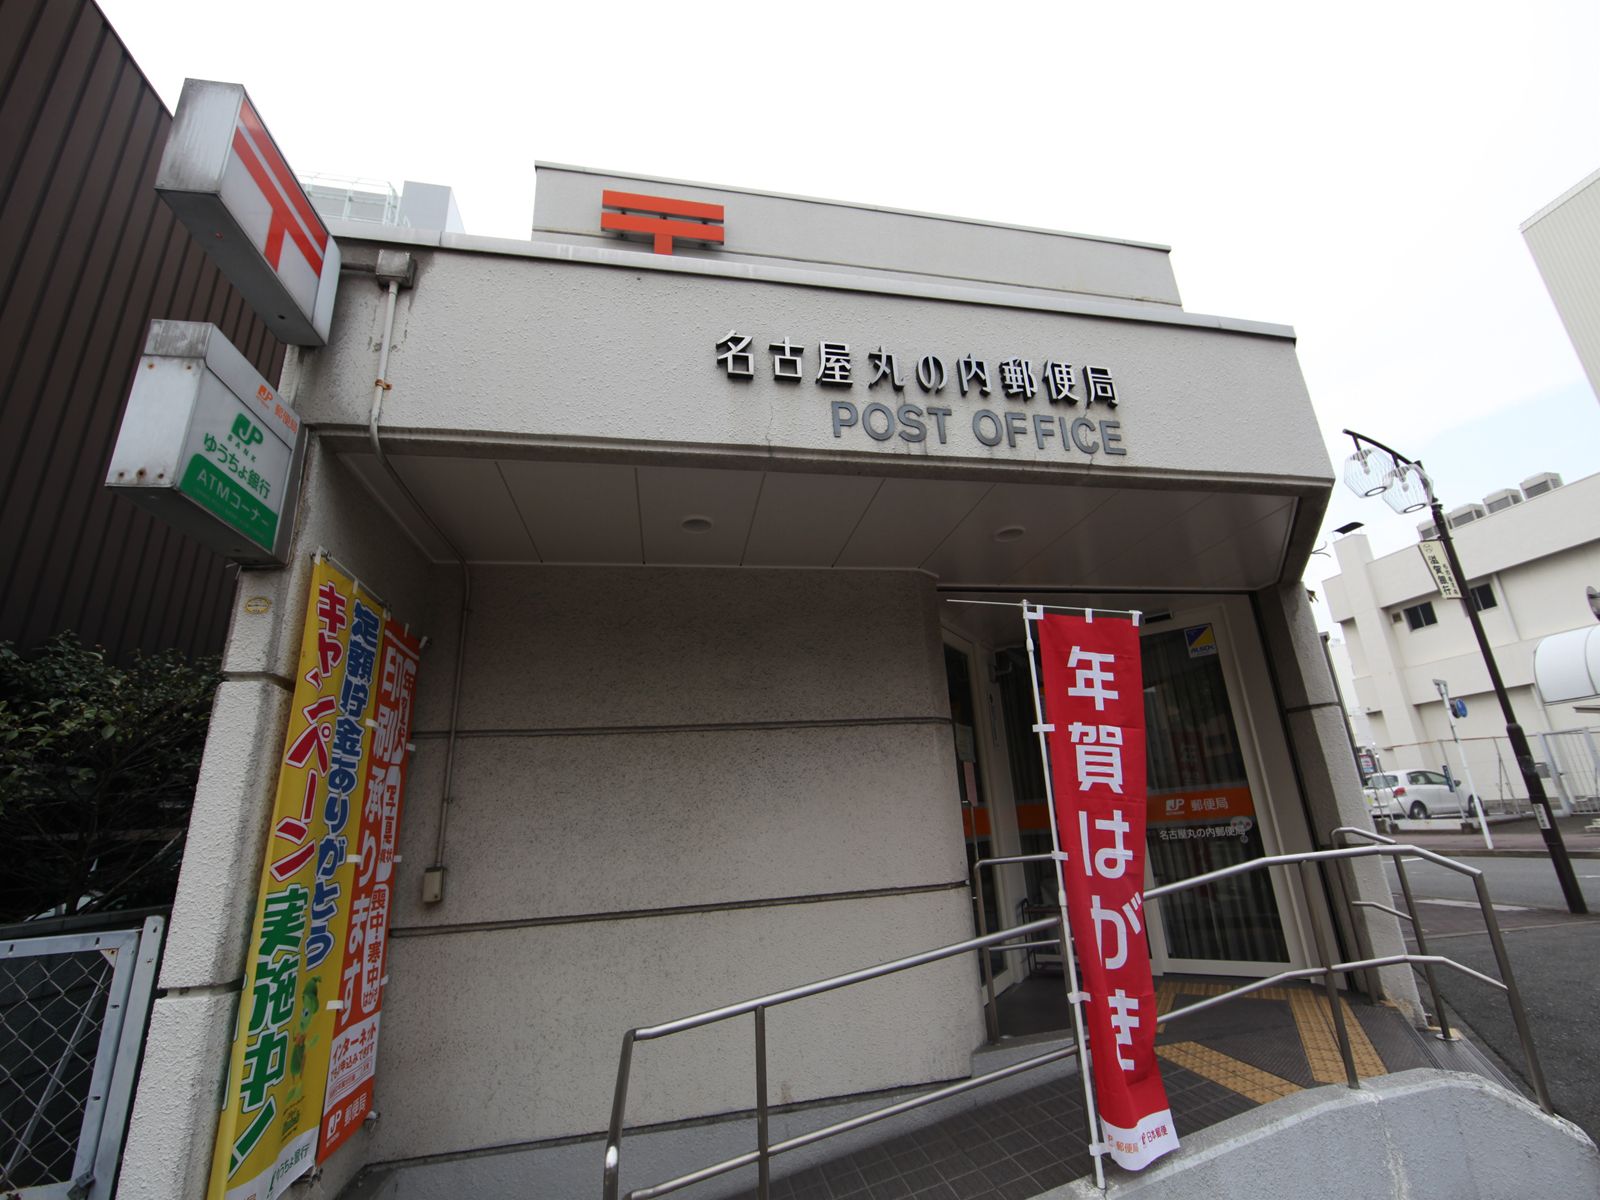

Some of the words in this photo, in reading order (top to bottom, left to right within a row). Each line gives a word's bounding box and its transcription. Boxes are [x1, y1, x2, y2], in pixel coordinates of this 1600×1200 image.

[716, 330, 1120, 408] 名古屋丸の内郵便局
[228, 434, 257, 463] BANK
[232, 413, 263, 446] JP
[831, 401, 952, 444] POST
[972, 409, 1127, 456] OFFICE
[204, 432, 271, 499] ゆうちょ銀行
[197, 468, 269, 526] ATMコーナー
[271, 582, 346, 879] キャンペーン
[1191, 797, 1228, 811] 郵便局
[341, 647, 404, 1026] 印刷承ります
[1067, 646, 1142, 1071] 年賀はがき
